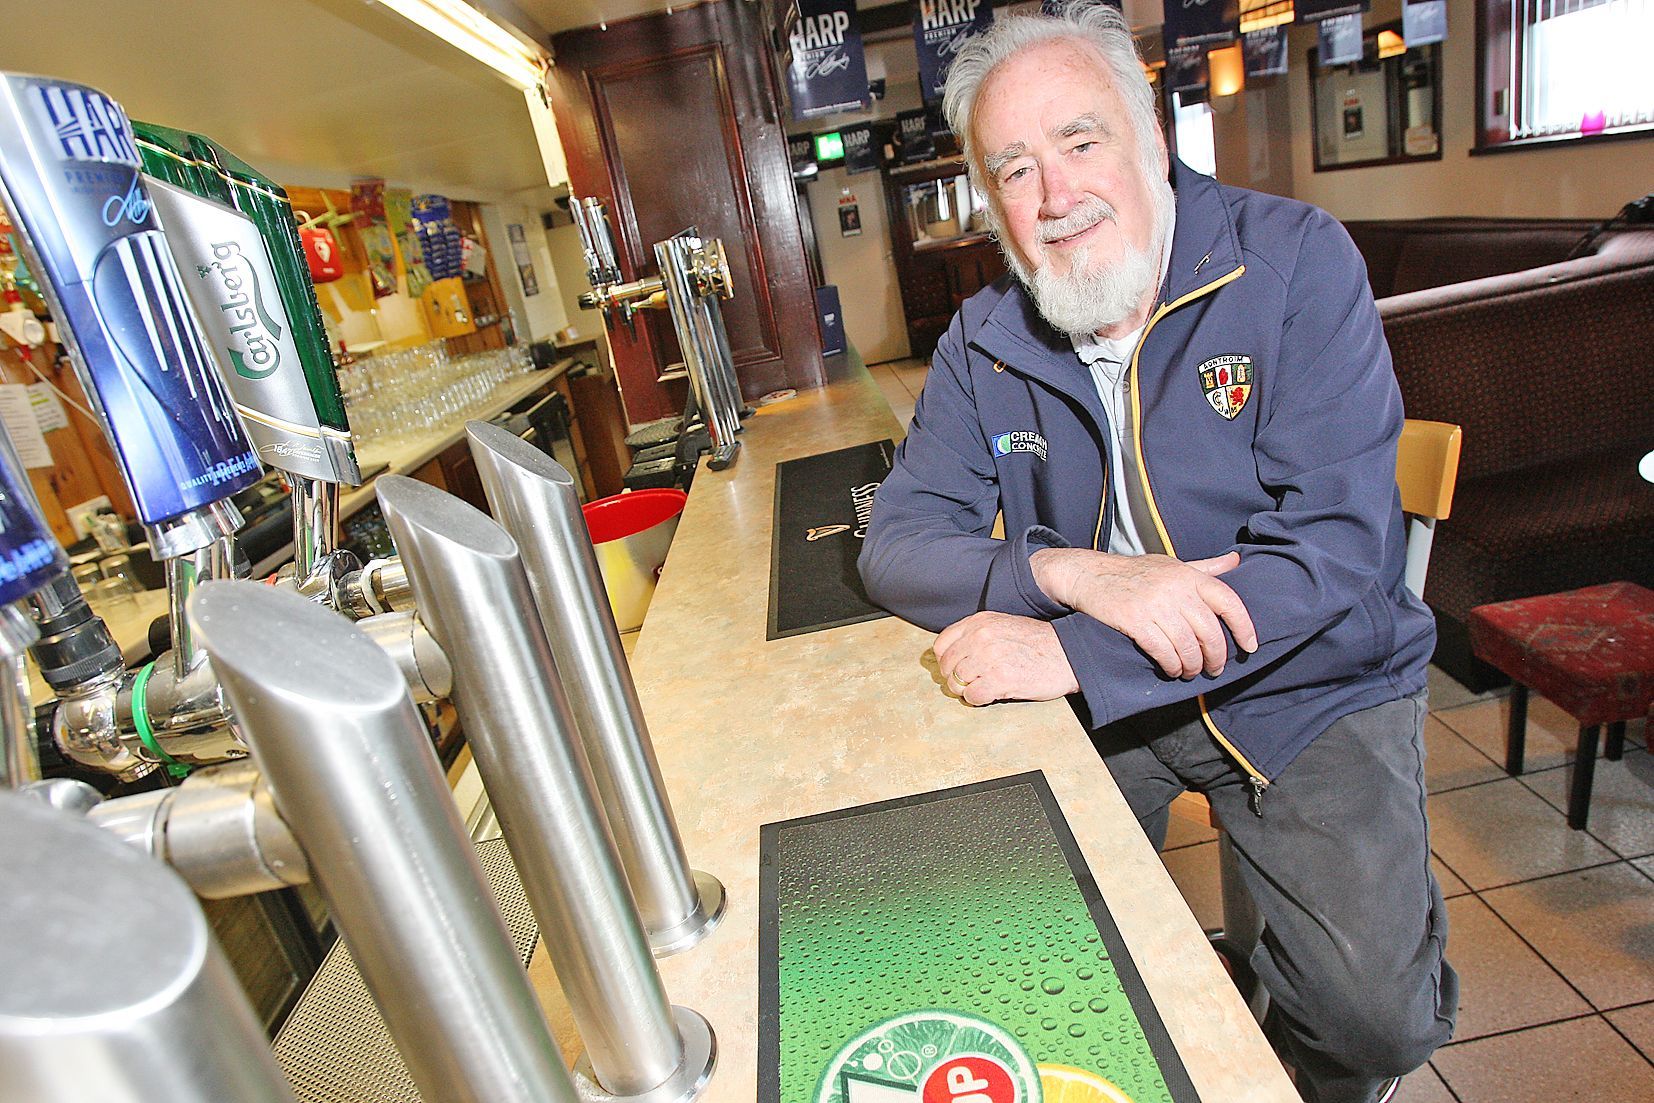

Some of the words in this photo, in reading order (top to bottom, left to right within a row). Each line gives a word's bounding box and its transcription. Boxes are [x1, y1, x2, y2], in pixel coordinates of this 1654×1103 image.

[789, 10, 849, 52] HARP
[920, 0, 980, 30] HARP
[790, 140, 810, 157] ARP
[210, 240, 282, 380] Carlsberg
